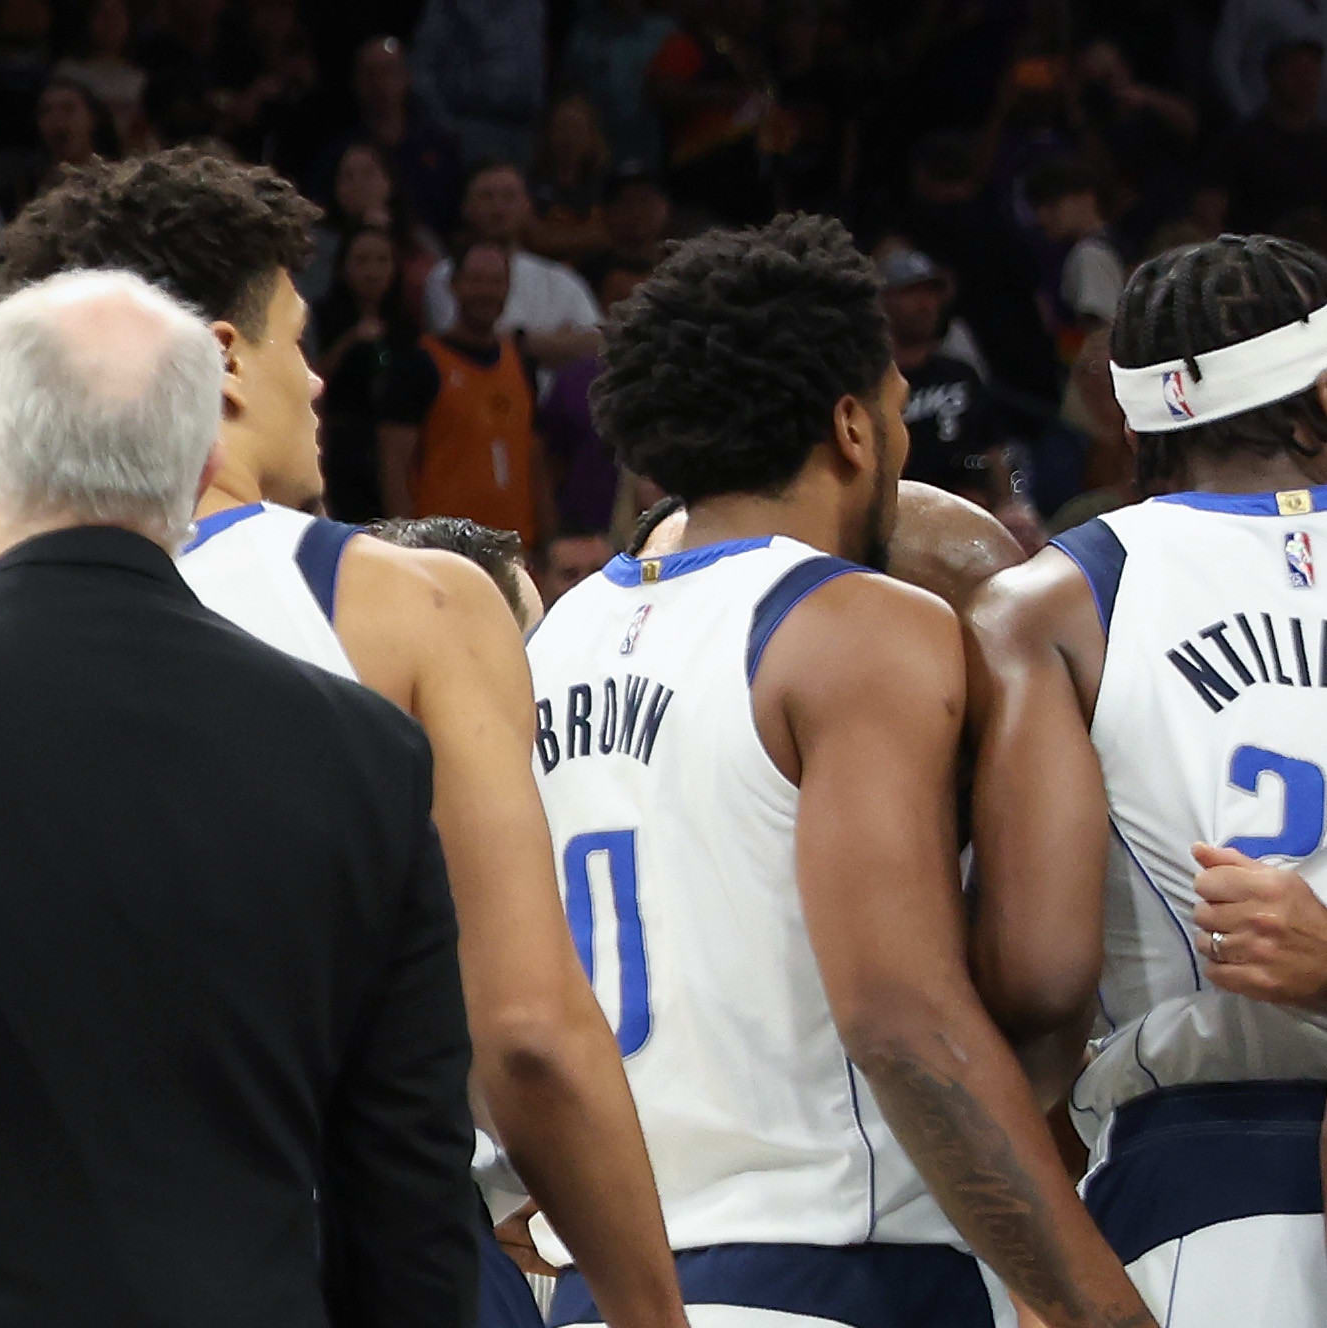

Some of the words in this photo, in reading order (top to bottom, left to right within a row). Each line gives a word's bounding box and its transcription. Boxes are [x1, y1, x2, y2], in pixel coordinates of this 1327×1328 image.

[535, 674, 675, 776] BROWN
[1218, 744, 1326, 860] 2
[563, 827, 655, 1060] 0
